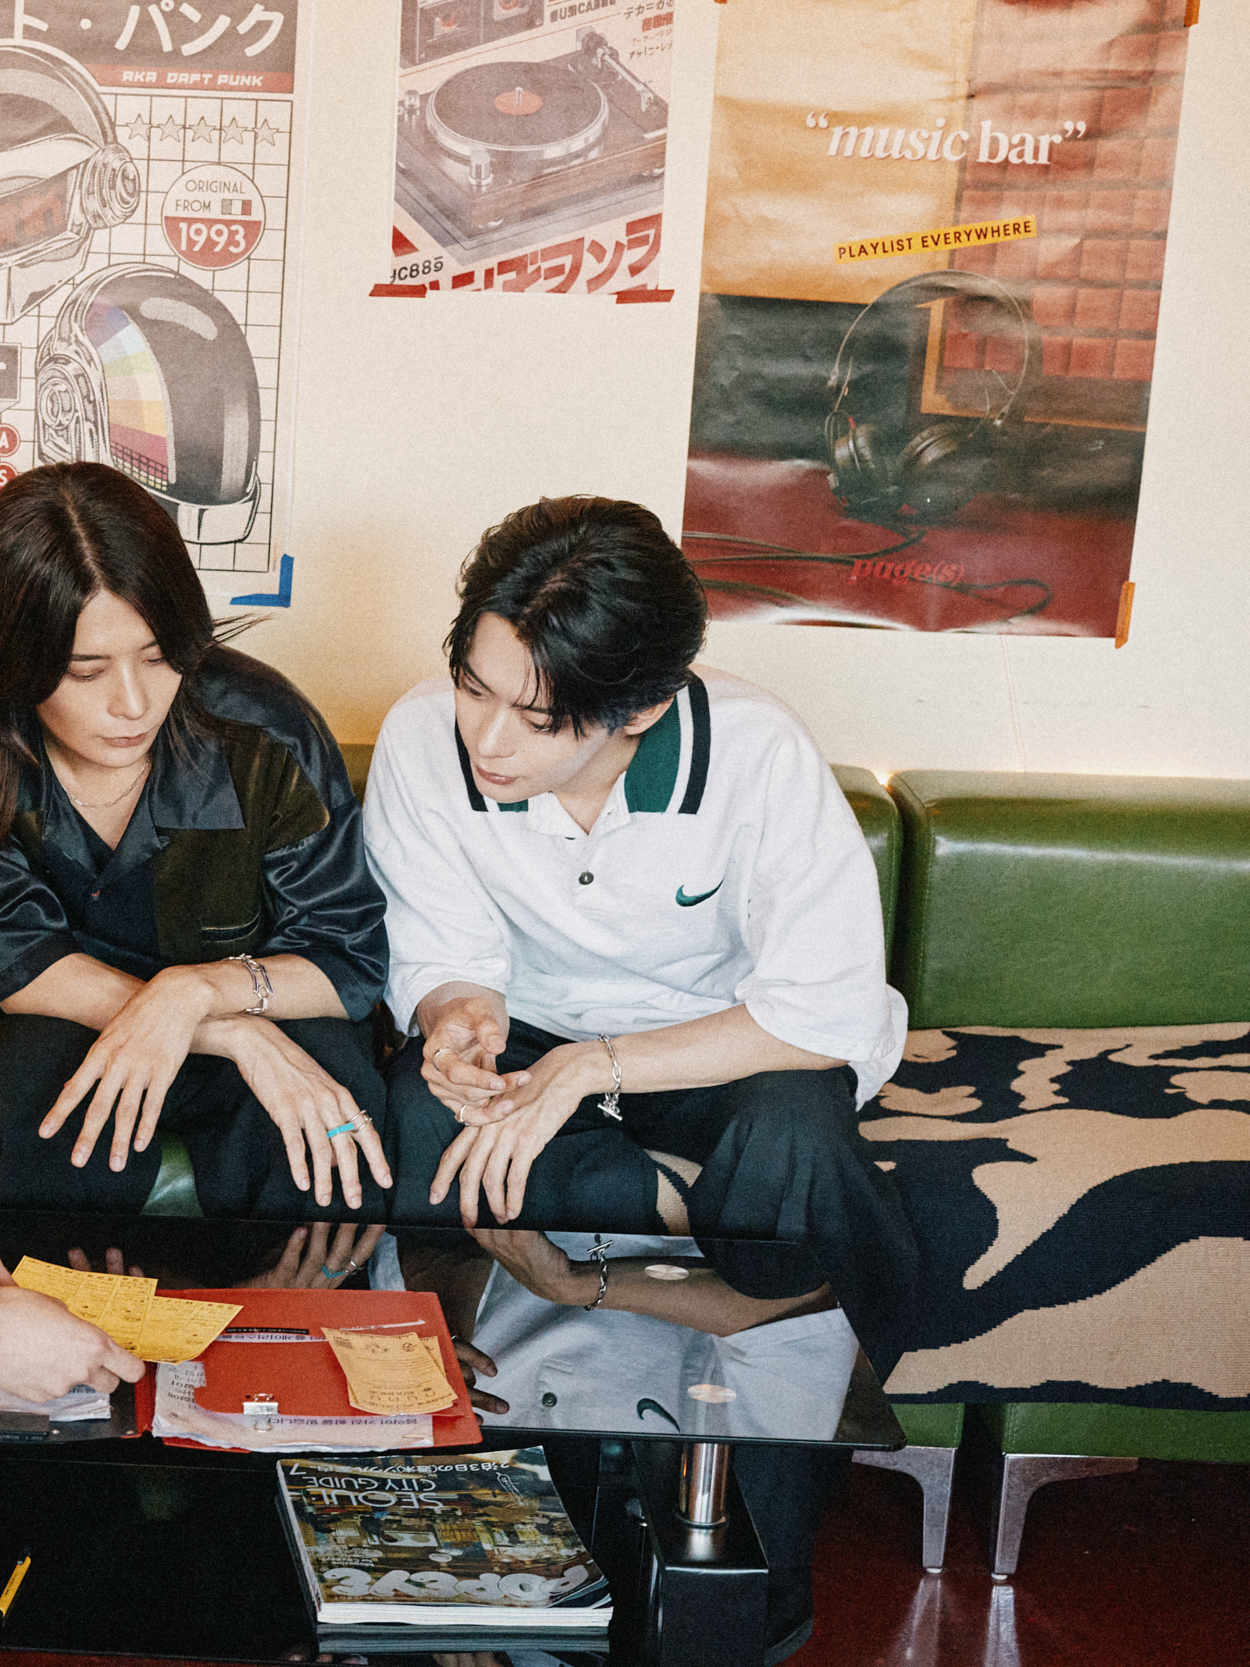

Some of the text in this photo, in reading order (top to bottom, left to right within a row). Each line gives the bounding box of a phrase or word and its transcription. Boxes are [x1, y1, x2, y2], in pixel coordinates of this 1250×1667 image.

[123, 70, 157, 84] AKA
[166, 71, 212, 86] DAFT
[217, 73, 263, 87] PUNK
[185, 179, 246, 194] ORIGINAL
[175, 199, 212, 213] FROM
[178, 222, 246, 254] 1993
[837, 220, 1033, 260] PLAYLIST EVERYWHERE
[306, 1475, 437, 1492] CITY GUIDE
[306, 1488, 444, 1509] SEOUL
[323, 1564, 589, 1598] POPEYE
